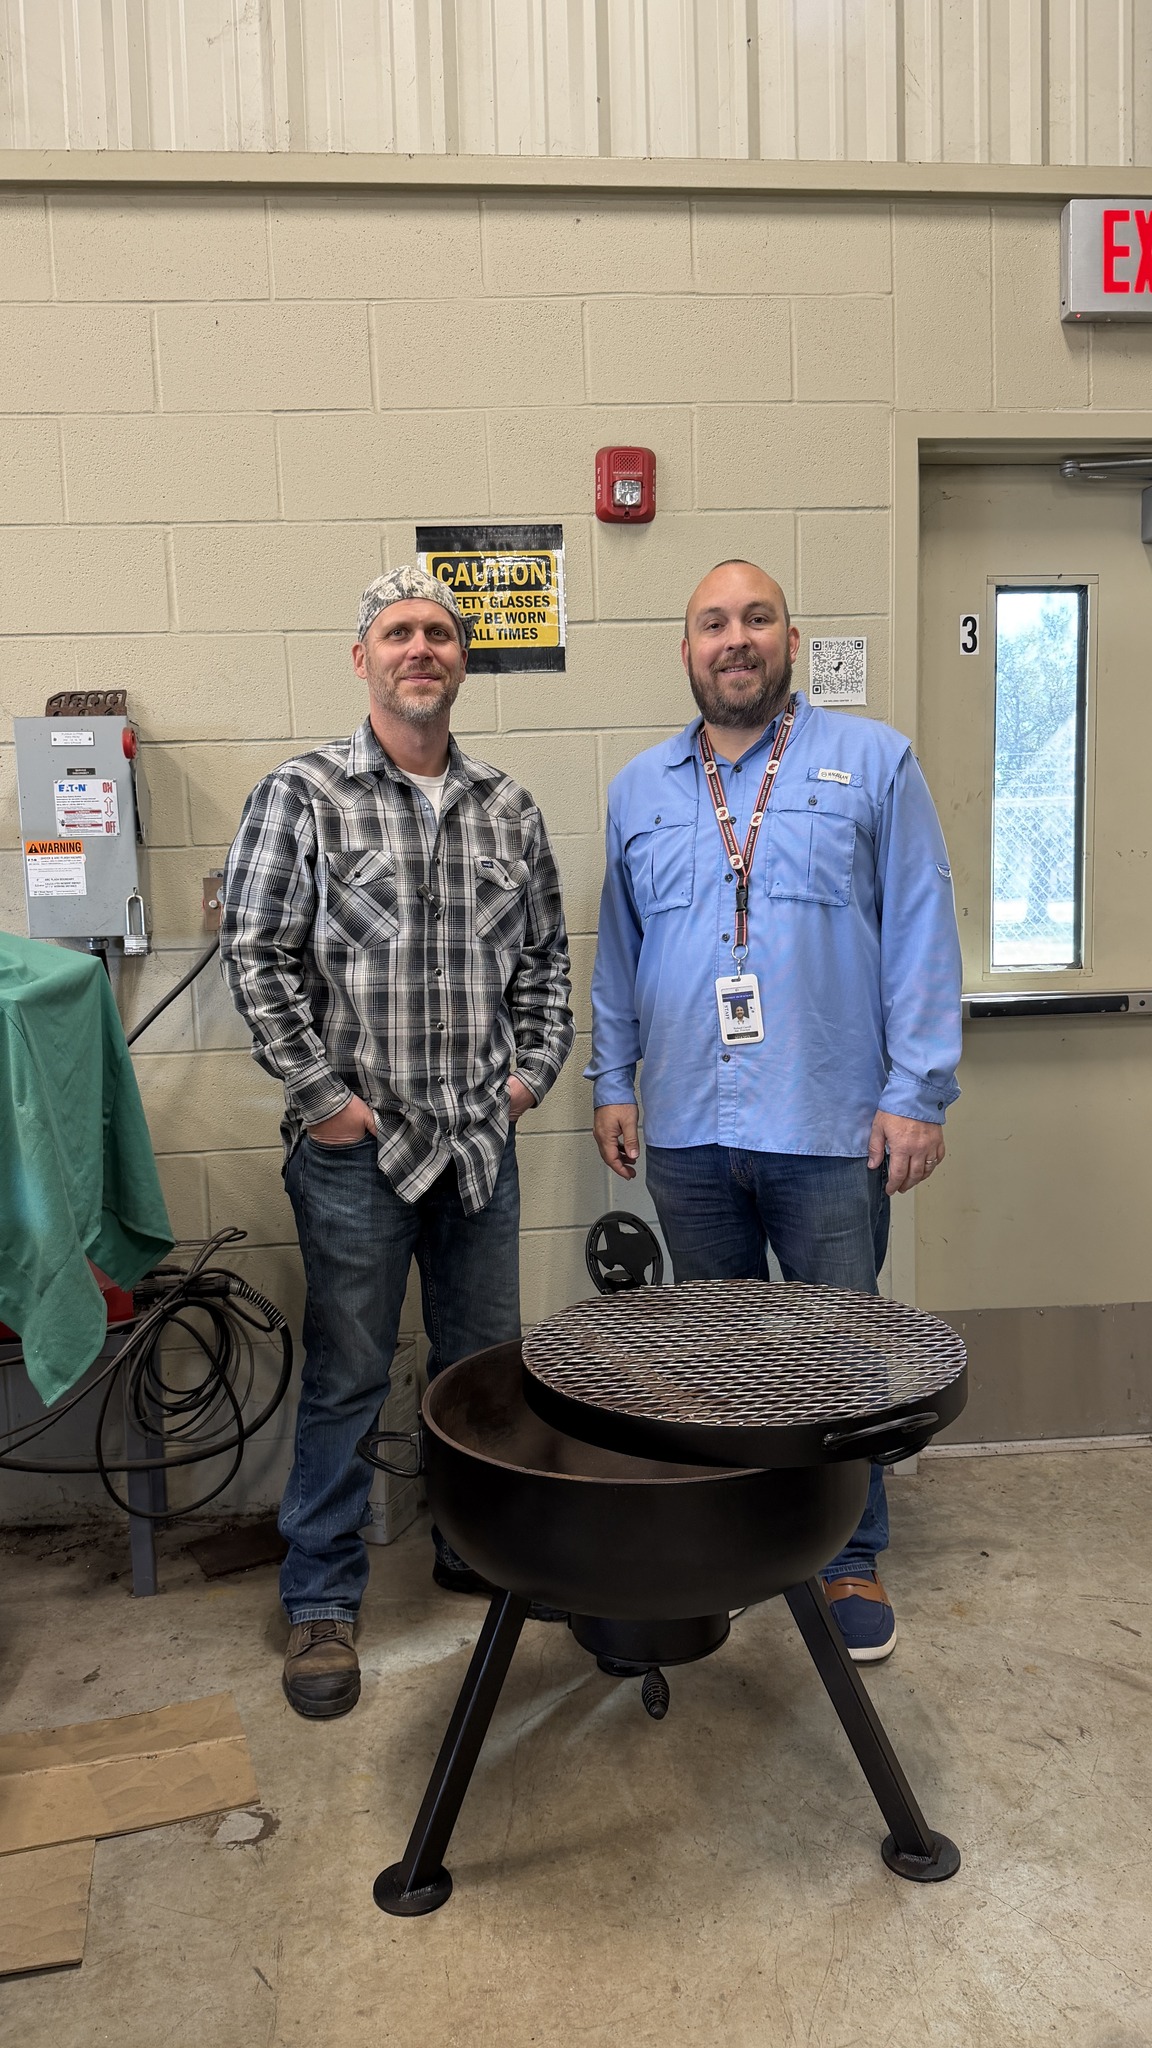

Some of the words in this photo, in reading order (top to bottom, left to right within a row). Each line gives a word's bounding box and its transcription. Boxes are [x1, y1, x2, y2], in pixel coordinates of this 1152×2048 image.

[1103, 210, 1152, 293] EX
[436, 562, 547, 586] CAUTION
[457, 596, 487, 609] FETY
[490, 595, 550, 609] GLASSES
[484, 612, 503, 625] BE
[505, 611, 546, 624] WORN
[472, 629, 494, 641] ALL
[496, 628, 538, 640] TIMES
[962, 616, 978, 653] 3
[775, 738, 783, 757] UNIVERSITY
[103, 782, 113, 793] ON
[711, 776, 719, 794] UNIVERSITY
[759, 789, 767, 809] UNIVERSITY
[105, 821, 116, 833] OFF
[723, 823, 733, 842] UNIVERSITY
[39, 842, 82, 853] WARNING
[745, 842, 753, 864] UNIVERSITY
